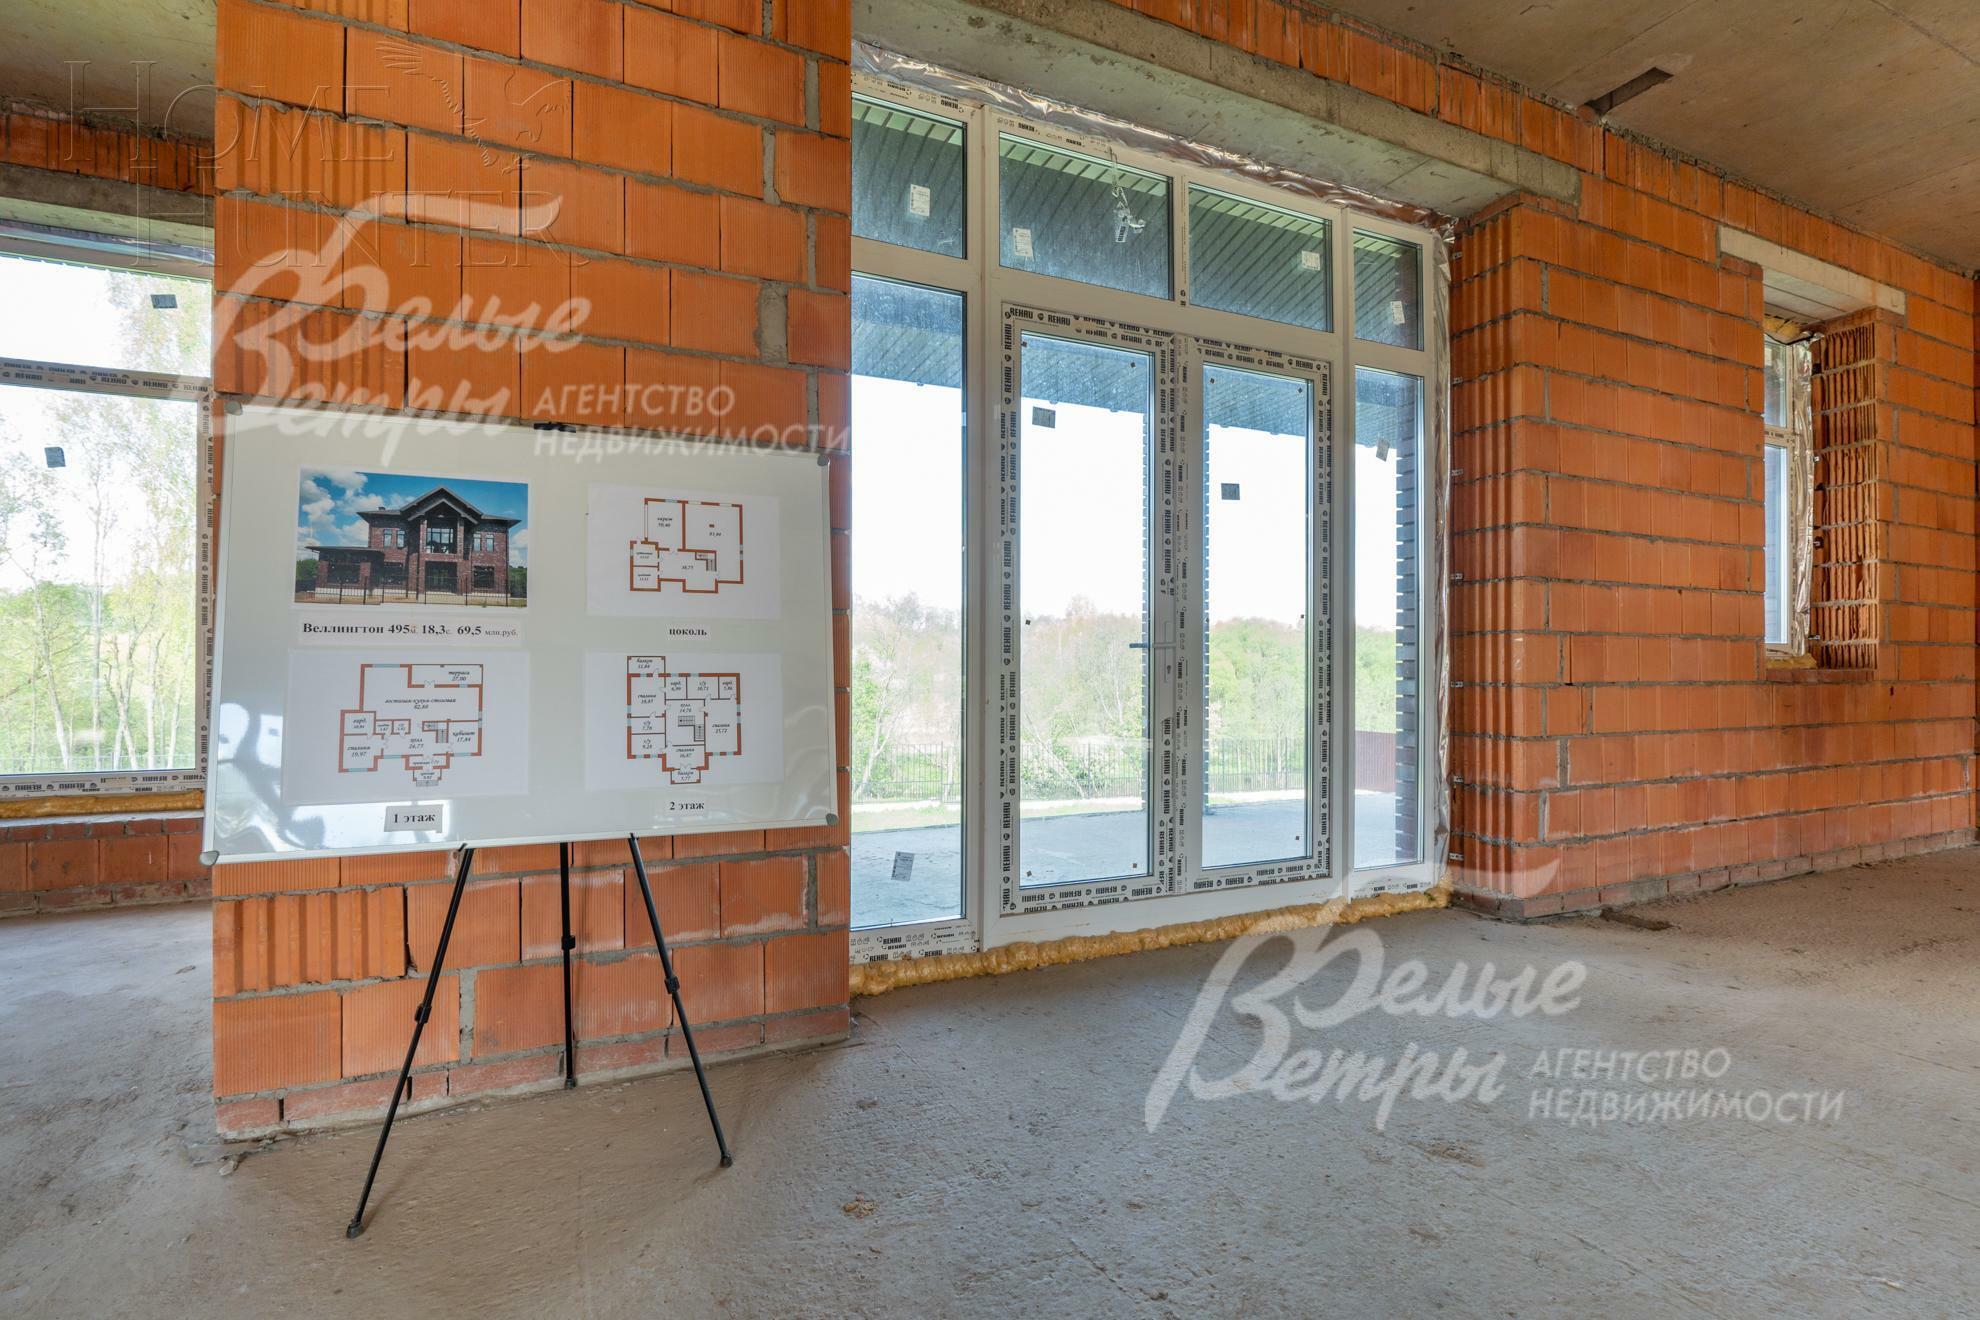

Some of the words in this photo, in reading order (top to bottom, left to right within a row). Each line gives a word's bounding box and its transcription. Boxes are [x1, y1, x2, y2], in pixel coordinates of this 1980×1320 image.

[1010, 307, 1034, 320] REHAU
[1048, 314, 1071, 326] REHAU
[1004, 324, 1012, 350] REHAU
[1296, 360, 1314, 370] REHAU
[1004, 367, 1012, 393] REHAU
[303, 622, 384, 634] Веллингтон
[457, 625, 482, 636] 69,5
[669, 801, 675, 810] 2
[679, 802, 705, 810] этаж
[394, 813, 399, 823] 1
[403, 814, 436, 823] этаж
[1003, 802, 1011, 828] REHAU
[1003, 845, 1011, 872] REHAU
[1194, 880, 1213, 888] REHAU
[1225, 877, 1244, 885] REHAU
[1131, 887, 1153, 897] REHAU
